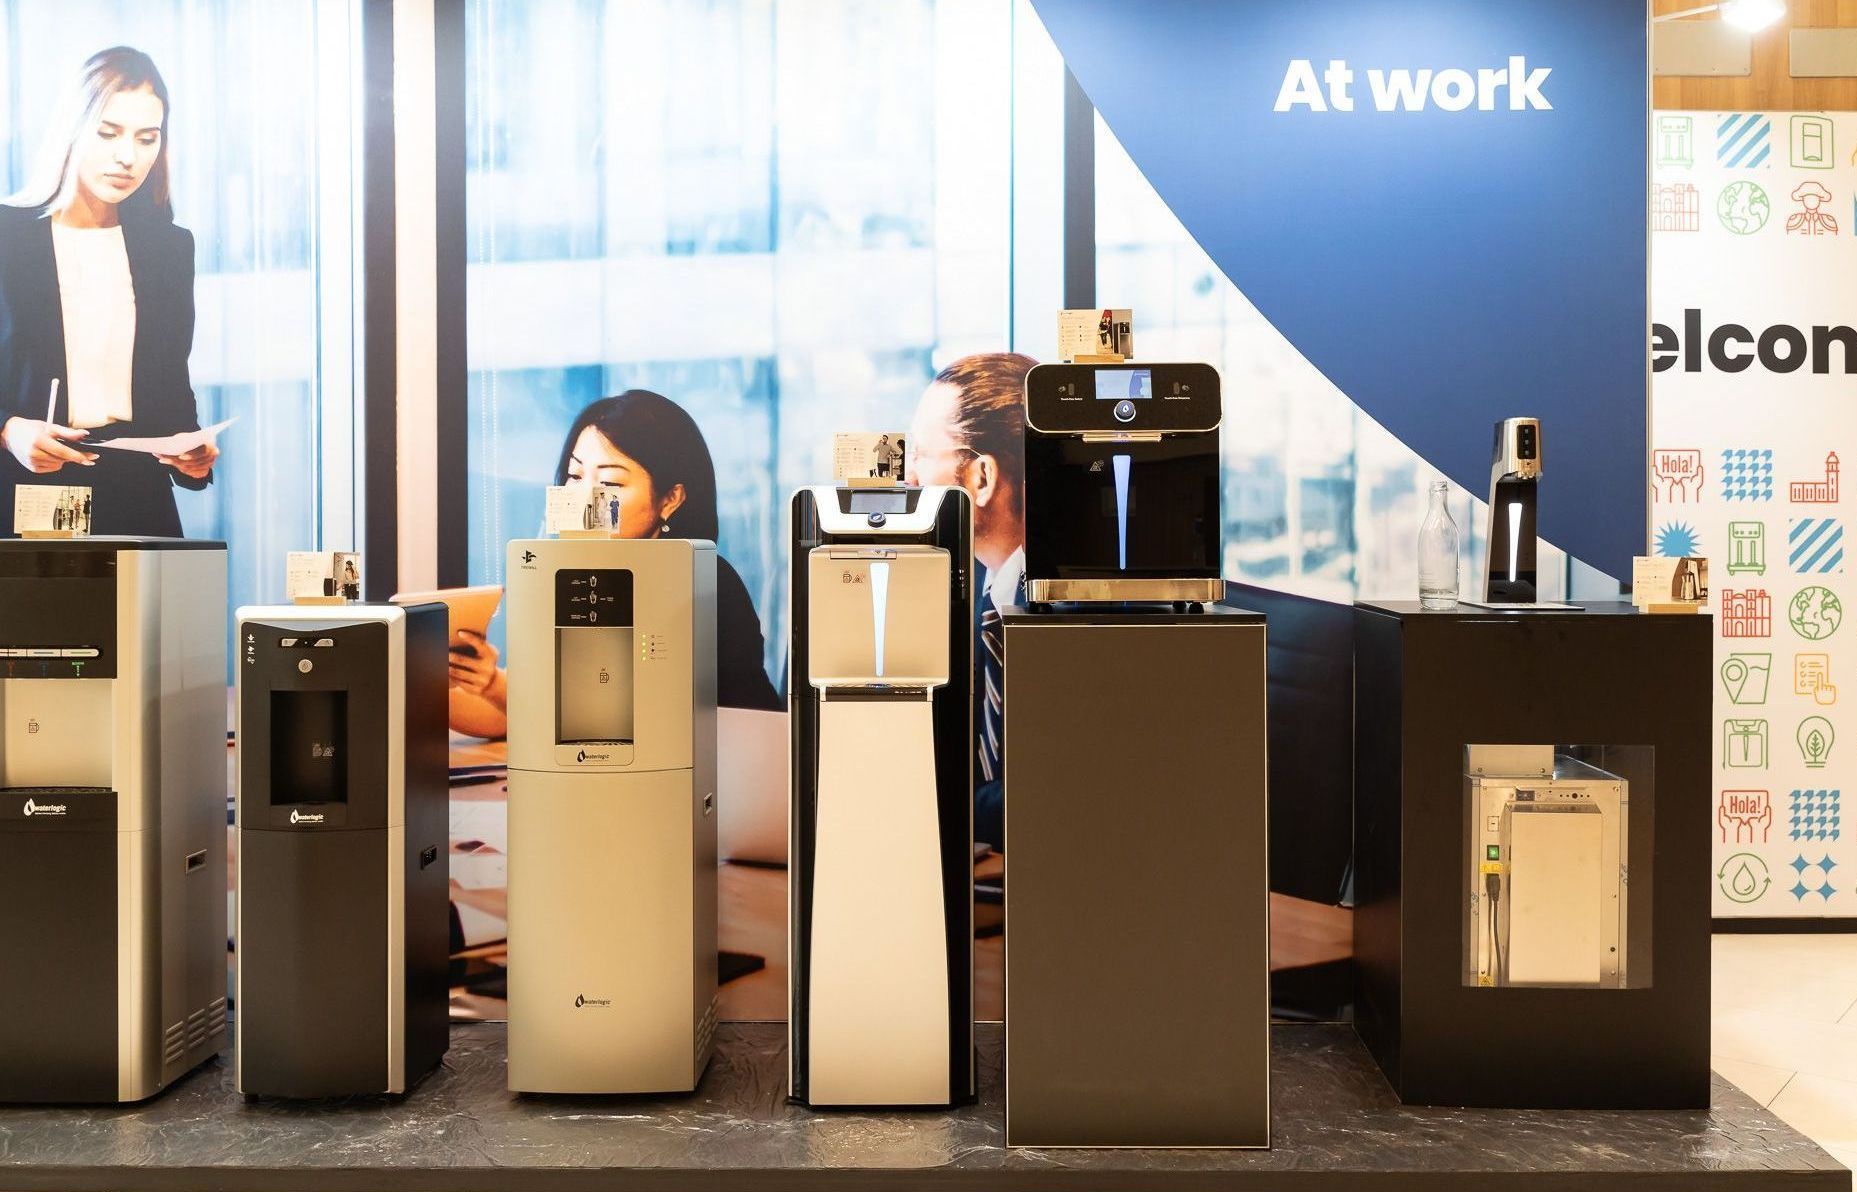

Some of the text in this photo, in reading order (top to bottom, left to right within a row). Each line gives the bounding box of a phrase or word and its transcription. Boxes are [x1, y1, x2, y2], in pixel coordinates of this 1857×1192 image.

[1272, 55, 1554, 112] At work
[1662, 455, 1692, 473] Hola!
[34, 804, 67, 813] waterlogic
[1730, 795, 1761, 814] Hola!
